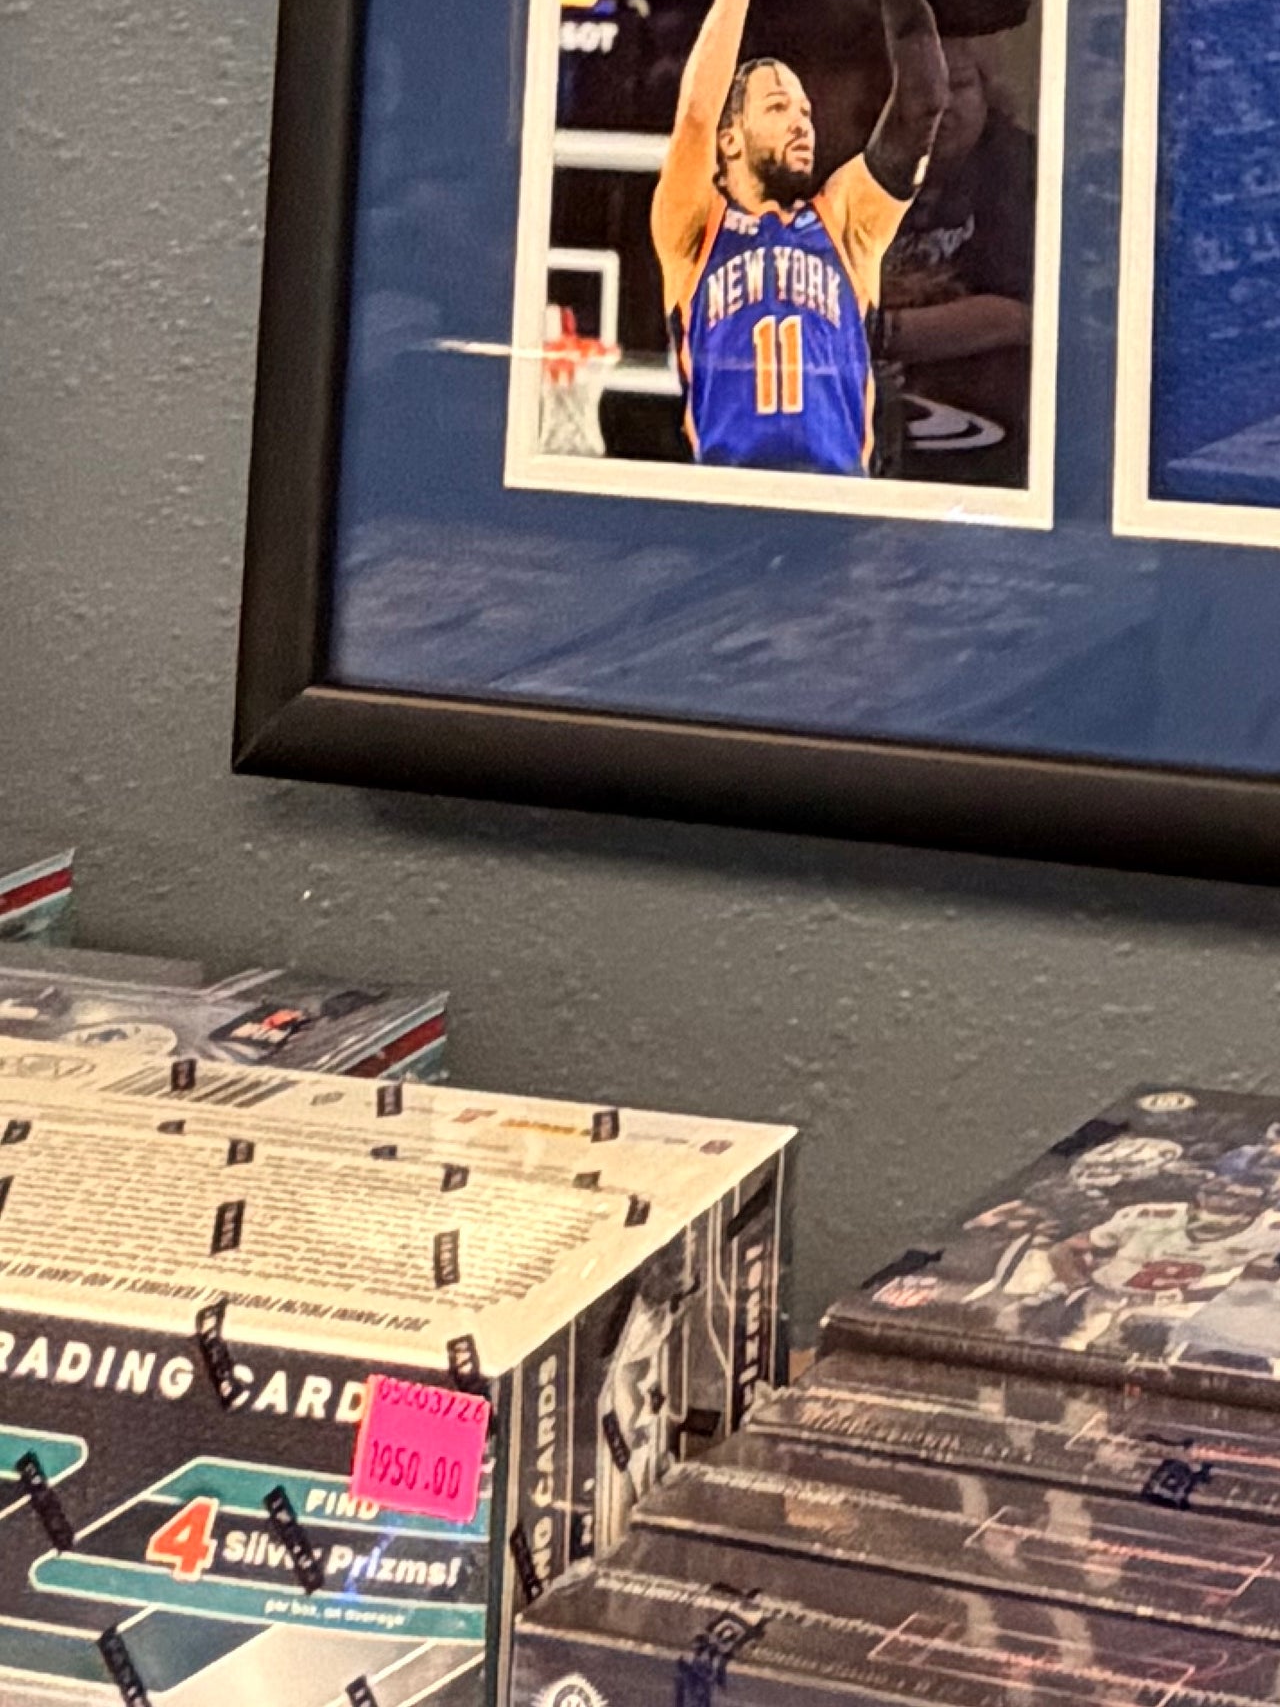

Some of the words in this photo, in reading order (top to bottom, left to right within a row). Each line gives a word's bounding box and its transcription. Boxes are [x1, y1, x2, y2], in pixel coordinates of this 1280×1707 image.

[706, 246, 766, 329] NEW
[772, 245, 843, 330] YORK
[752, 314, 804, 416] 11
[369, 1440, 462, 1500] 1950.00
[535, 1353, 559, 1509] CARDS
[145, 1495, 220, 1582] 4
[221, 1529, 323, 1572] Silv
[326, 1543, 462, 1589] Prizms!
